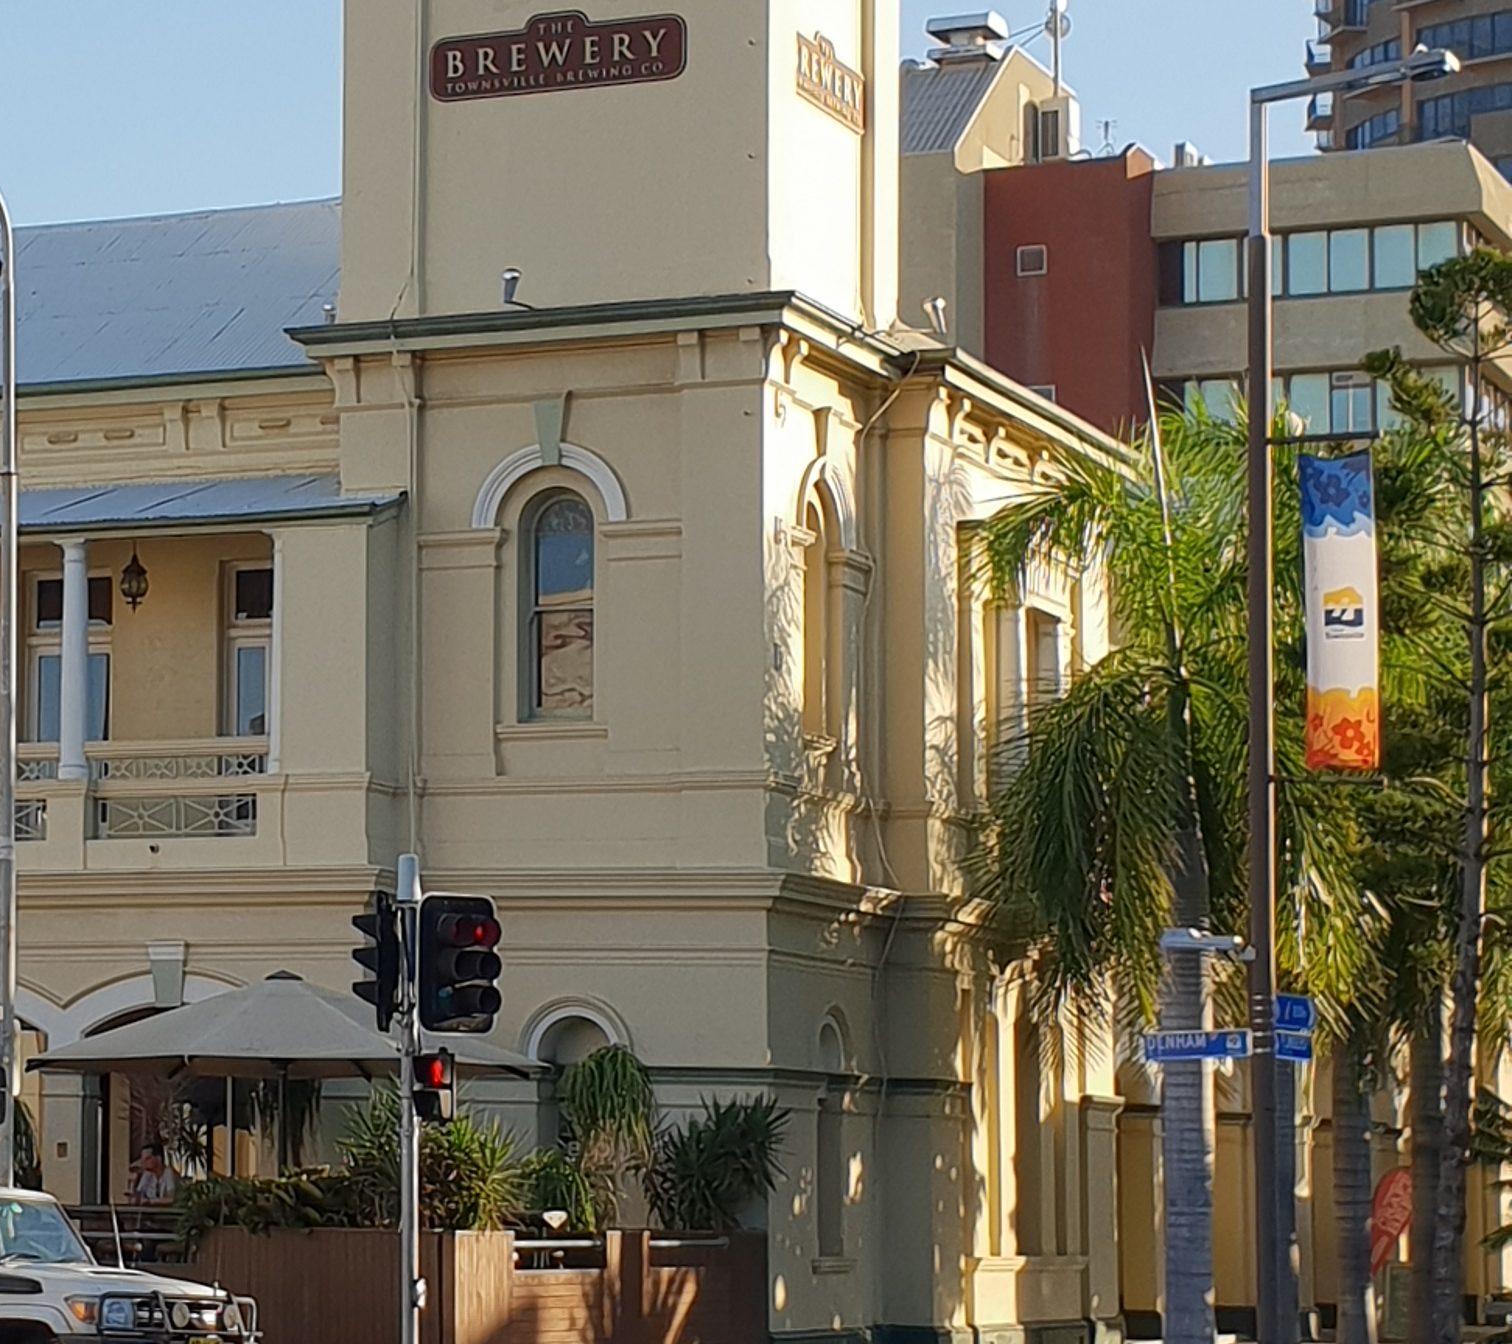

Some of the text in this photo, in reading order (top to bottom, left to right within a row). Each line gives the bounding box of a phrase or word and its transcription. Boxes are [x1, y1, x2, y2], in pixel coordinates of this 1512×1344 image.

[538, 20, 574, 36] THE
[445, 28, 667, 79] BREWERY
[445, 62, 664, 94] TOWNSVILLE BREWING CO
[1147, 1032, 1207, 1050] DENHAM
